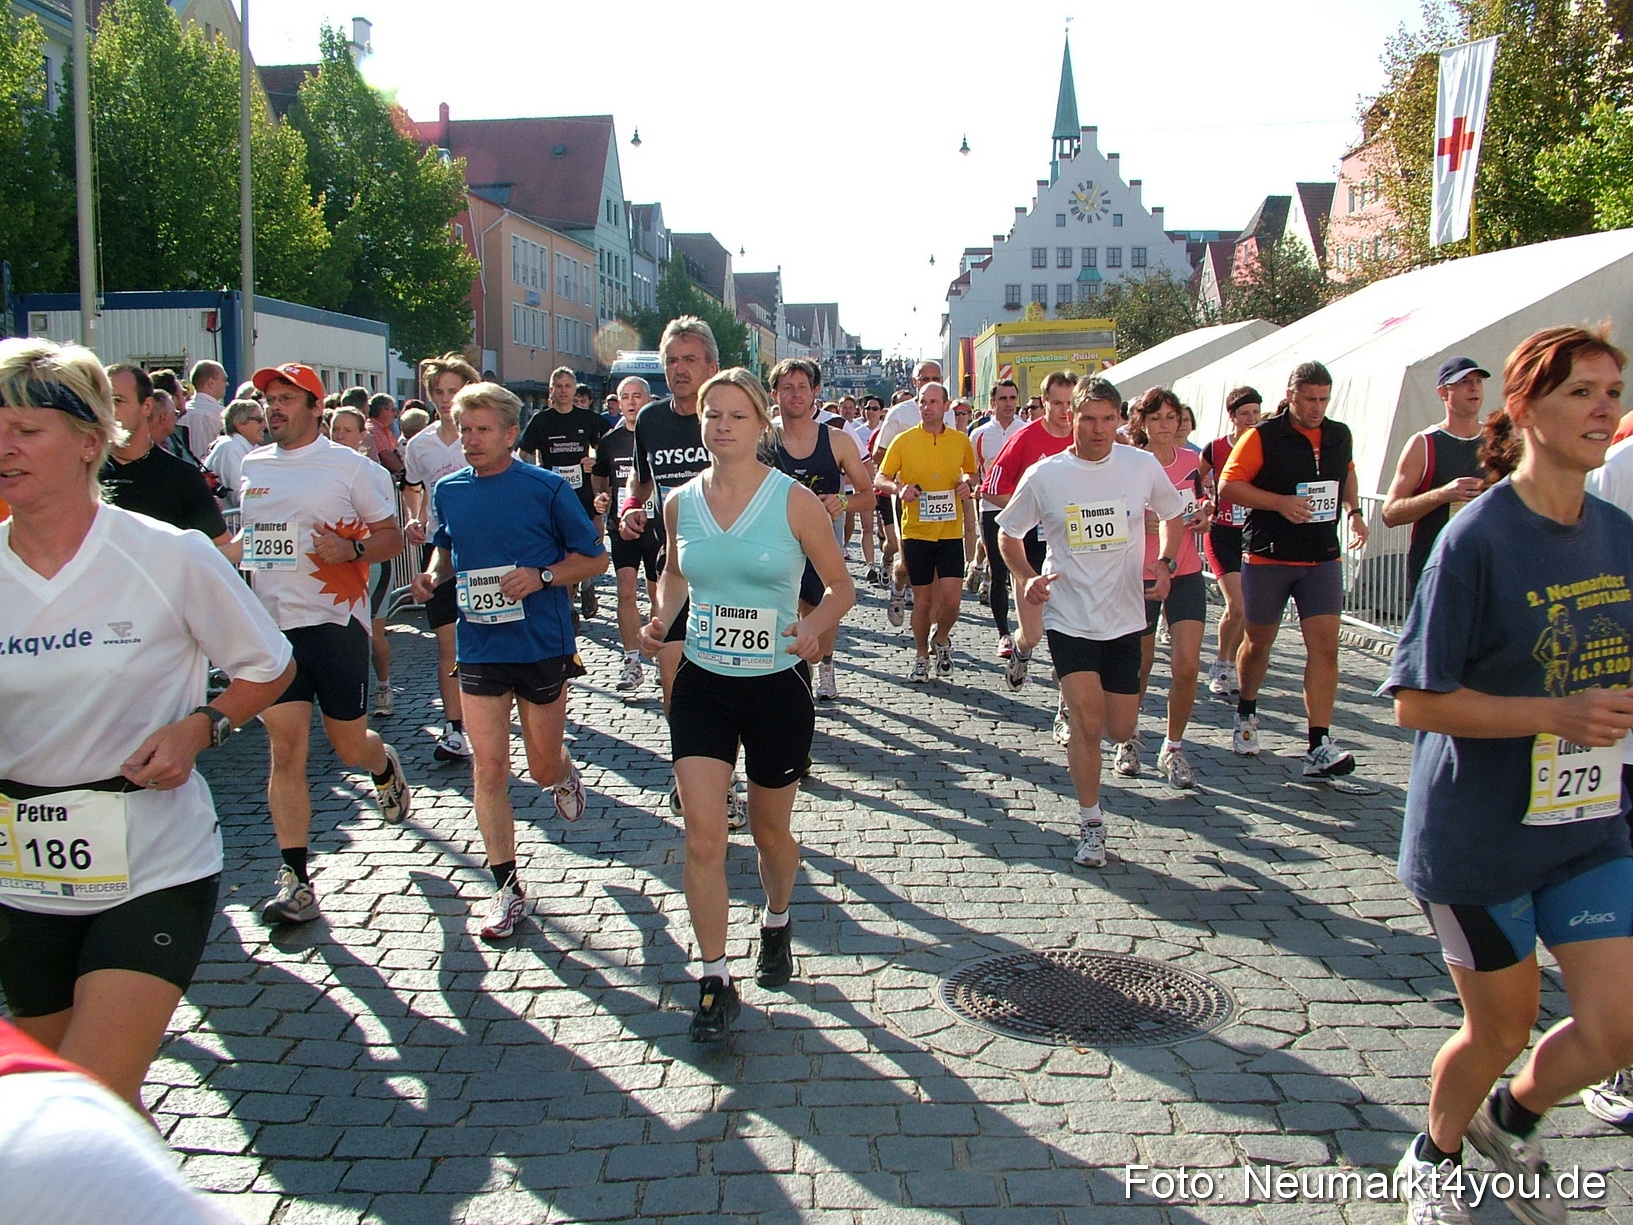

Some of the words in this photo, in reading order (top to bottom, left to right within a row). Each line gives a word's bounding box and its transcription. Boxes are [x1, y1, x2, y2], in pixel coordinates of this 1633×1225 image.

[655, 447, 713, 466] SYSCA
[928, 502, 954, 514] 2552
[1309, 498, 1336, 511] 2785
[1081, 507, 1115, 519] Thomas
[254, 522, 287, 532] Manfred
[1070, 523, 1077, 532] B
[1084, 522, 1114, 539] 190
[255, 539, 294, 556] 2896
[460, 592, 467, 602] C
[715, 604, 758, 620] Tamara
[700, 620, 708, 632] B
[715, 626, 770, 650] 2786
[1538, 767, 1549, 782] C
[1557, 764, 1601, 798] 279
[16, 803, 68, 822] Petra
[25, 838, 93, 870] 186
[74, 882, 128, 894] PFLEIDERER
